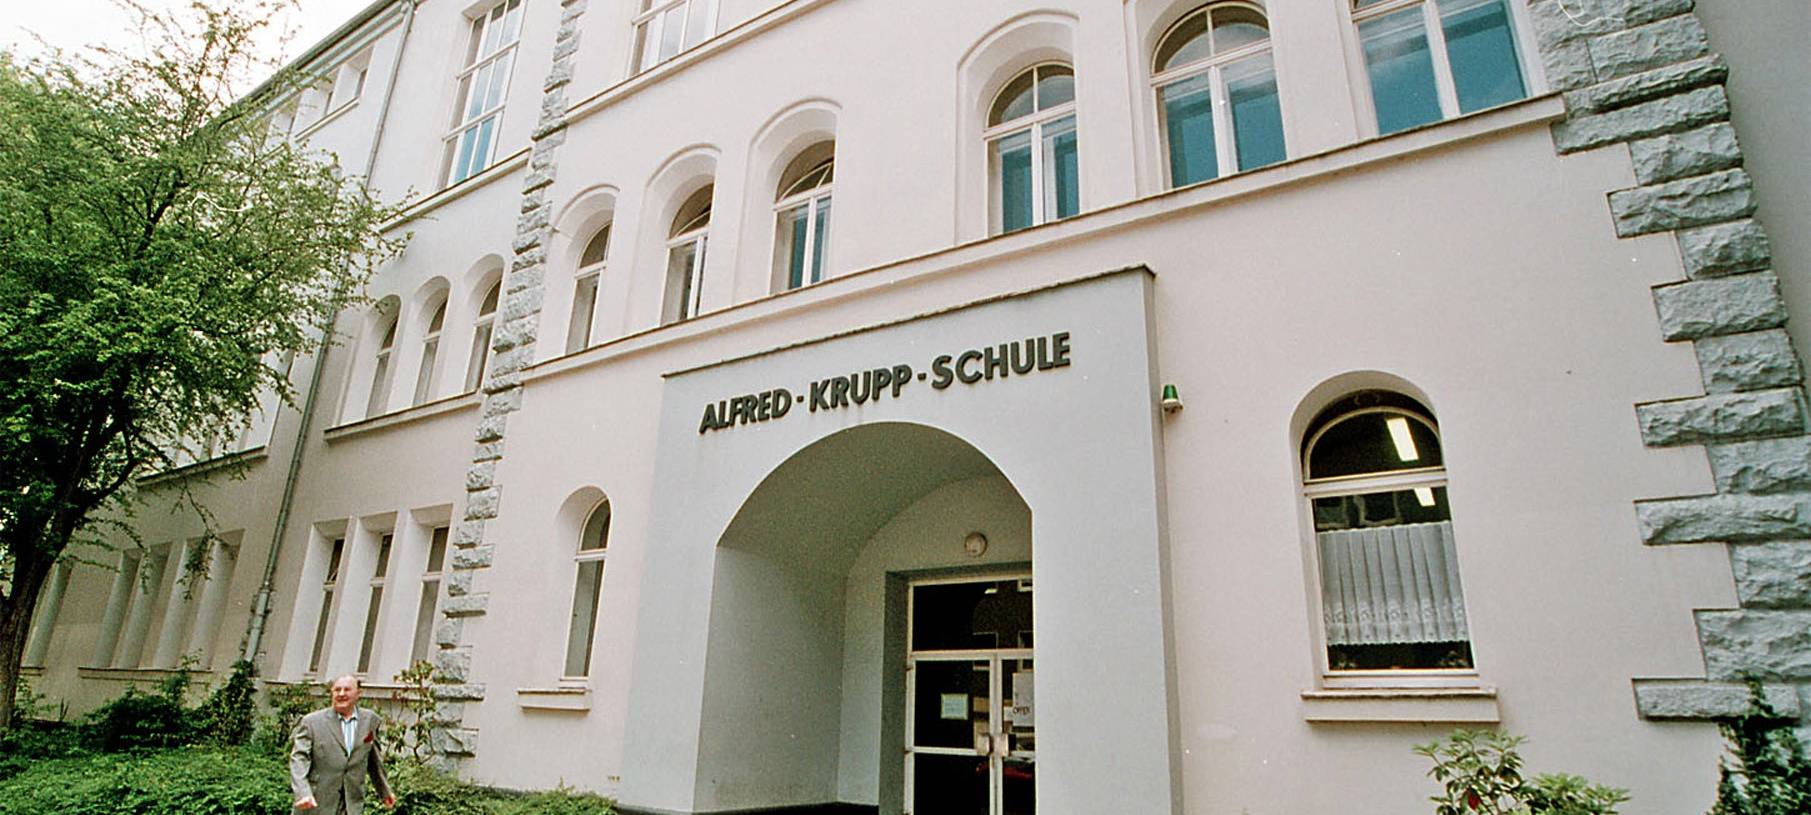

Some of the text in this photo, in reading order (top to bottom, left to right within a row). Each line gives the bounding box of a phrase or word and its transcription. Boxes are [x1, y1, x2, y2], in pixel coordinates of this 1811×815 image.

[699, 331, 1072, 435] ALFRED KRUPP SCHULE
